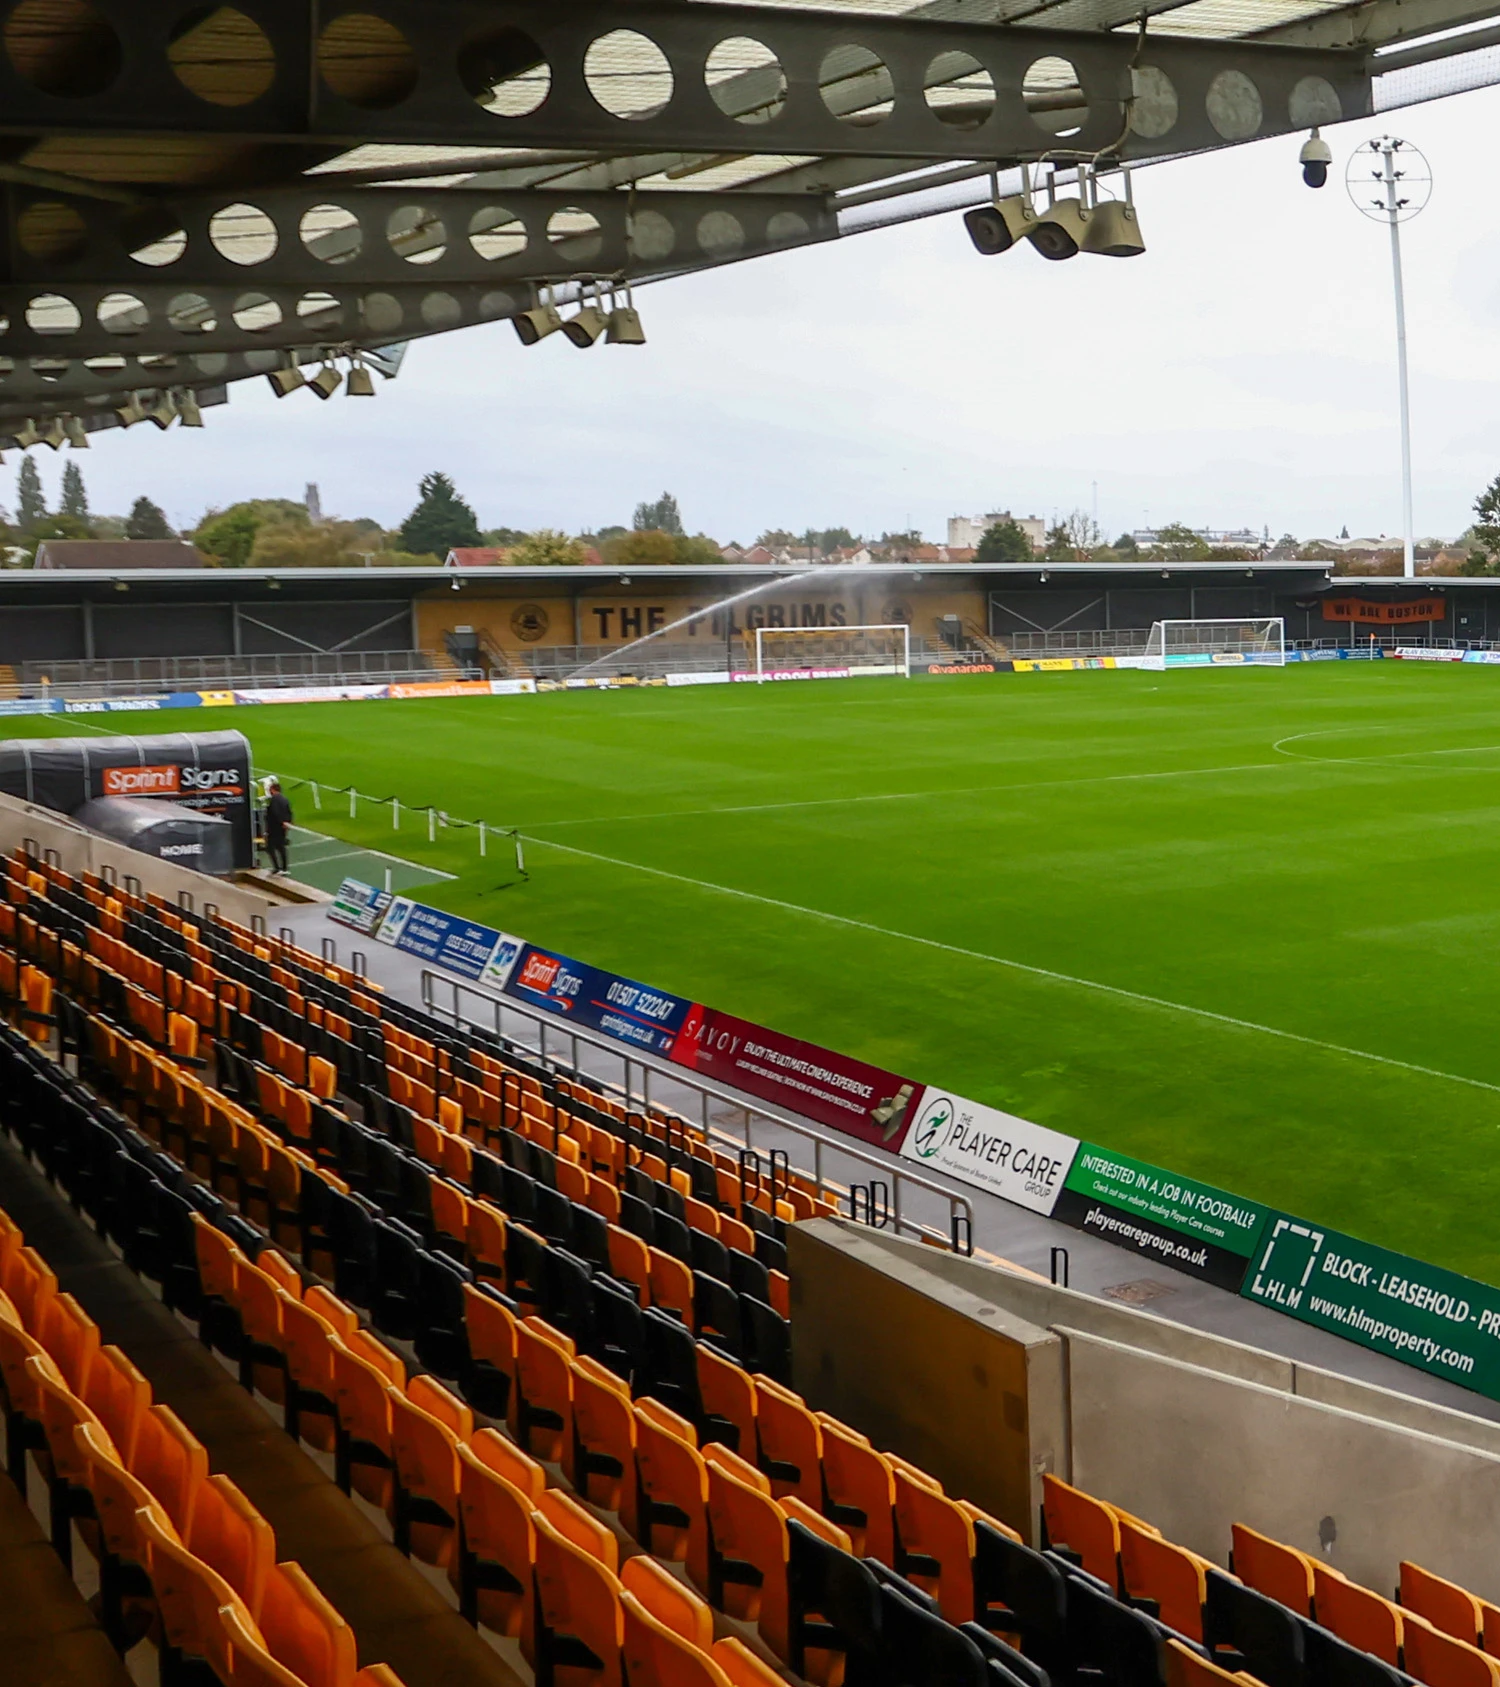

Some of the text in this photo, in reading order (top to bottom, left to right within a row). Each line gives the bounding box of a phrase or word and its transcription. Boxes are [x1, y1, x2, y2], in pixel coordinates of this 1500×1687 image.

[593, 603, 847, 638] THE PILGRIMS
[1388, 604, 1433, 618] BOSTON
[941, 664, 995, 674] vanarama
[108, 766, 239, 792] Sprint Signs
[160, 844, 203, 856] HOME
[523, 956, 556, 984] Sprint
[551, 967, 583, 996] Signs
[606, 982, 640, 1007] 01507
[684, 1019, 741, 1055] SAVOY
[830, 1074, 874, 1099] EXPERIENCE
[960, 1113, 974, 1127] THE
[949, 1124, 1063, 1187] PLAYER CARE
[1024, 1180, 1052, 1199] GROUP
[1080, 1154, 1256, 1230] INTERESTED IN A JOB IN FOOTBALL?
[1092, 1180, 1225, 1238] Check out our industry leading Player Care courses
[1084, 1206, 1209, 1268] playercaregroup.co.uk
[1264, 1278, 1303, 1310] HLM
[1322, 1252, 1373, 1288] BLOCK
[1377, 1272, 1470, 1323] LEASEHOLD
[1309, 1295, 1475, 1373] www.hlmproperty.com
